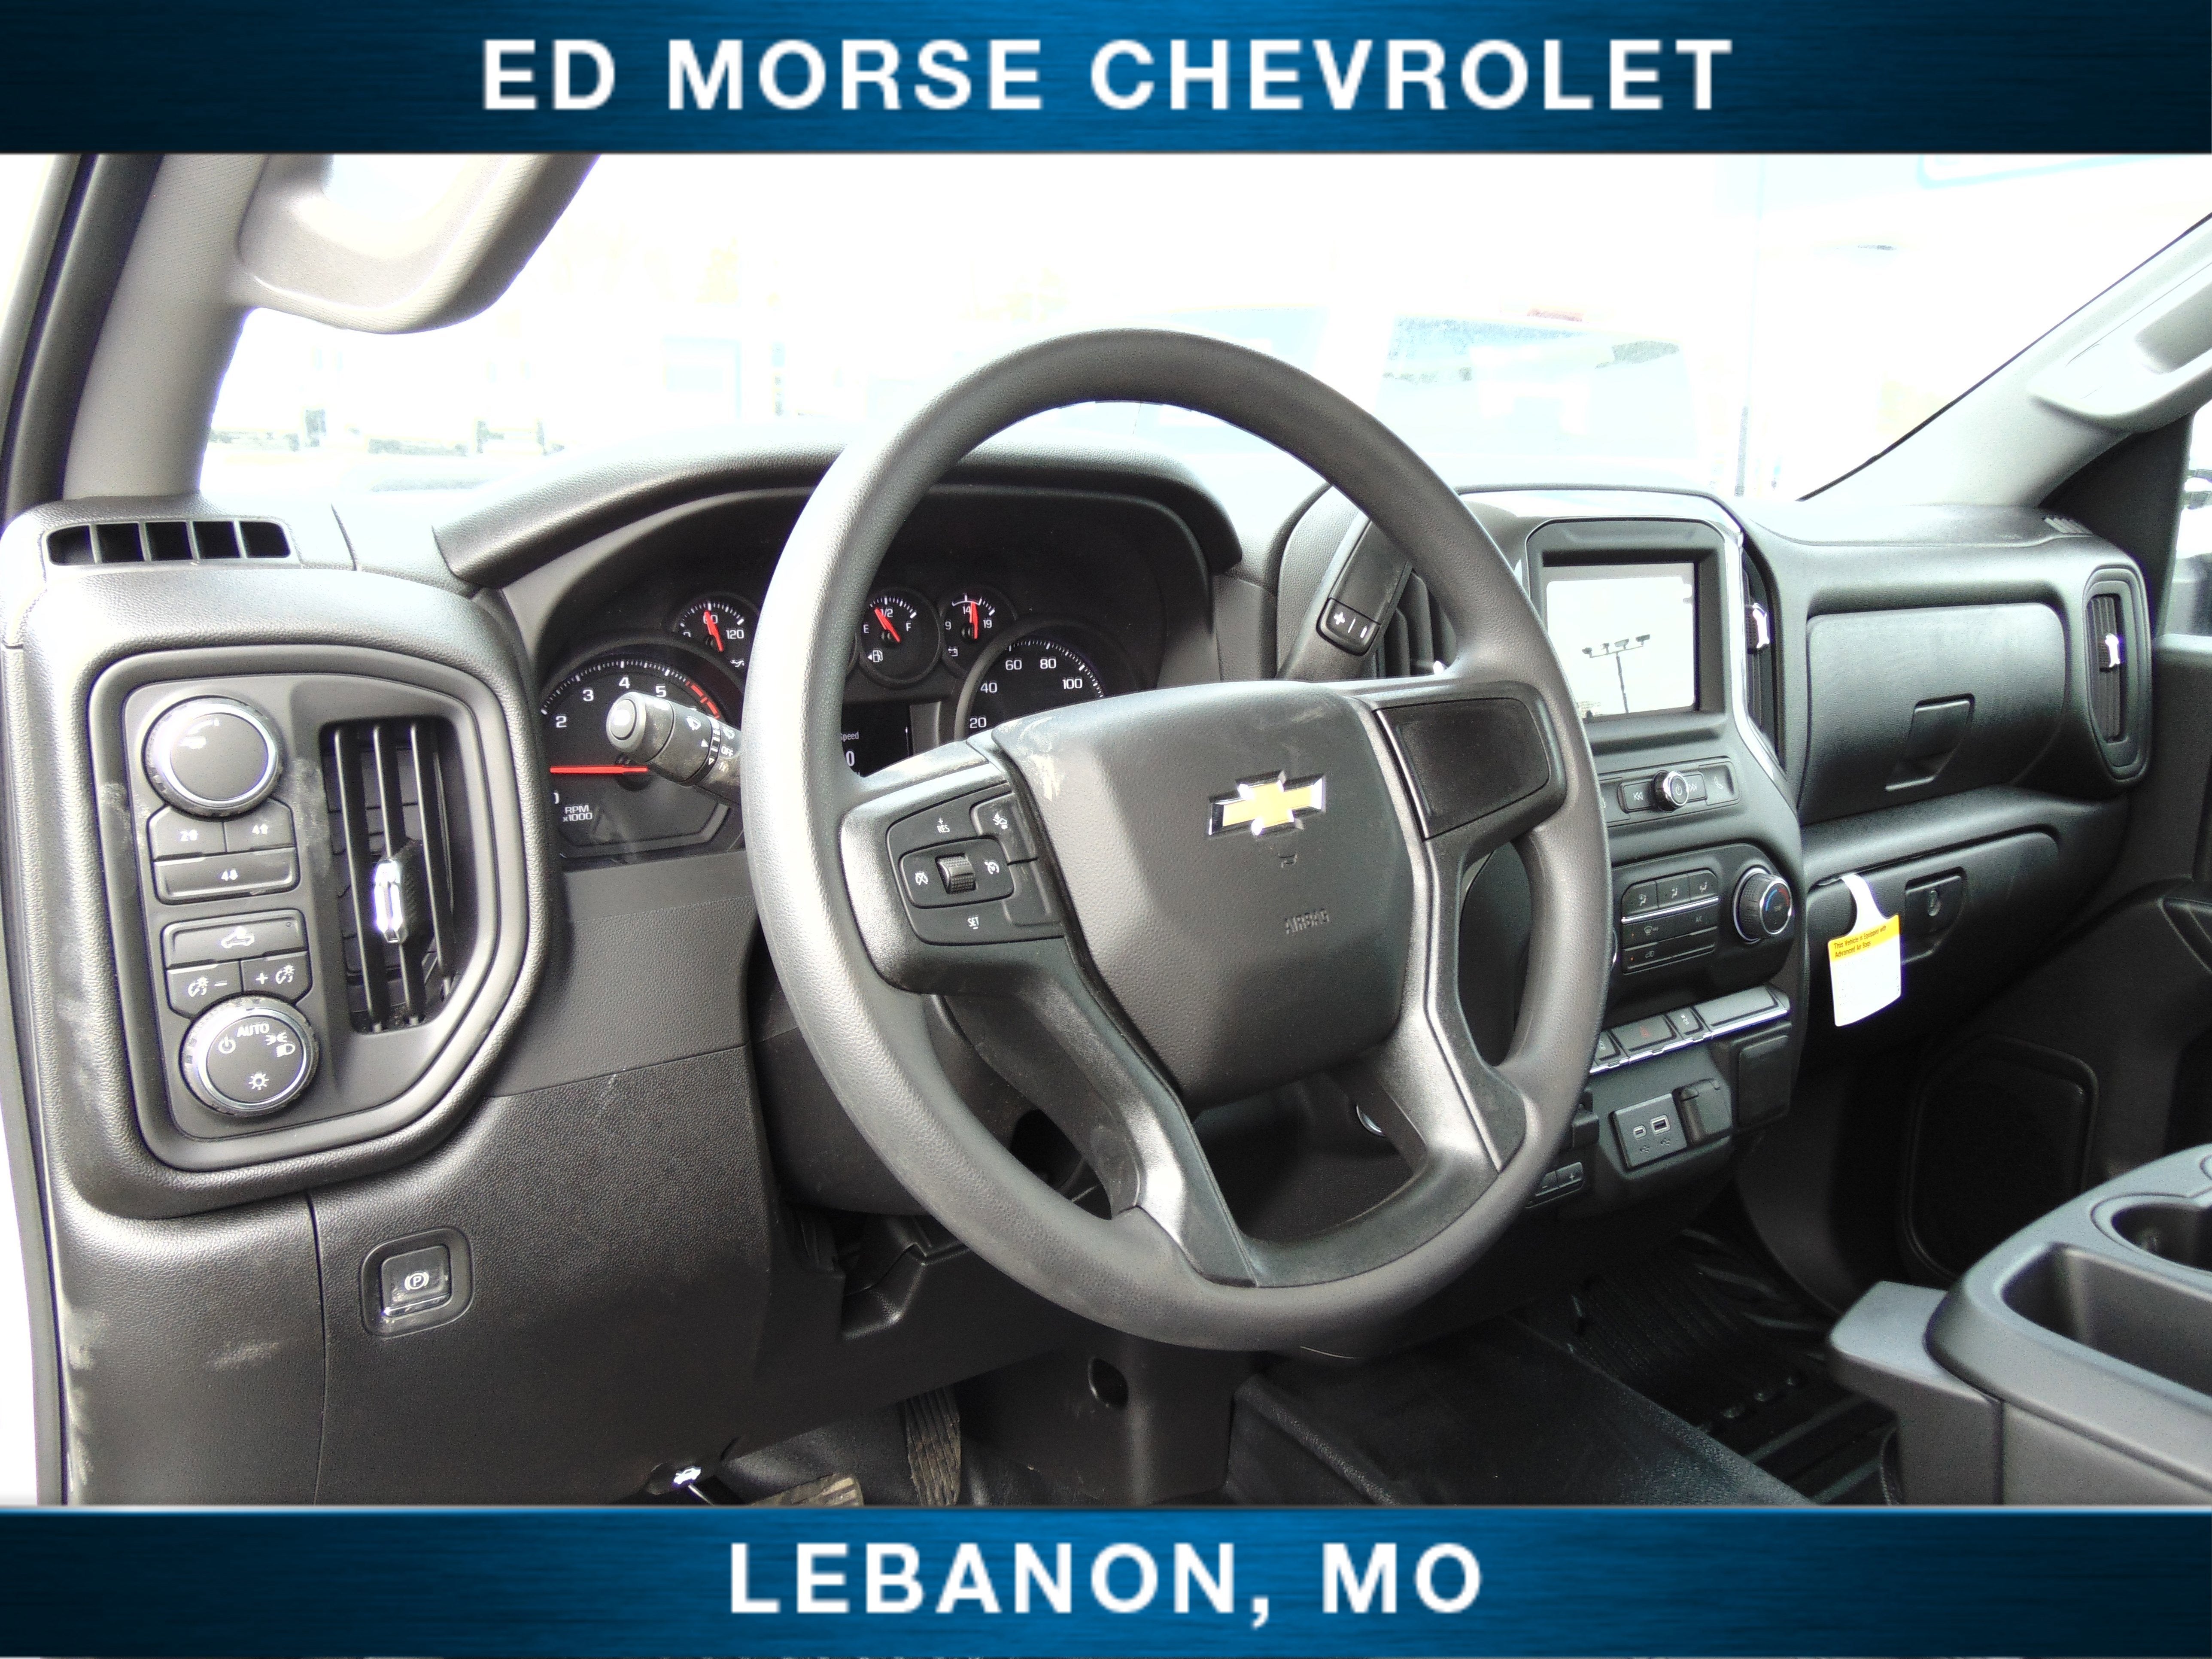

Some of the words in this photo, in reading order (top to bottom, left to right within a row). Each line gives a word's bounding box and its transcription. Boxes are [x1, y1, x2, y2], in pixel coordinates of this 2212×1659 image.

[863, 624, 869, 633] E
[905, 623, 912, 632] F
[945, 621, 951, 630] 9
[983, 619, 992, 628] 19
[726, 629, 744, 639] 120
[1005, 659, 1022, 671] 60
[1040, 658, 1057, 669] 80
[619, 677, 630, 689] 4
[980, 682, 997, 693] 40
[1062, 678, 1083, 690] 100
[582, 689, 594, 702] 3
[655, 685, 667, 698] 5
[555, 715, 567, 728] 2
[969, 717, 987, 729] 20
[721, 746, 734, 757] OFF
[846, 750, 855, 767] 0
[565, 805, 589, 814] RPM
[562, 812, 593, 823] x1000
[936, 824, 950, 833] RES
[967, 916, 980, 927] SET
[1285, 909, 1330, 934] AIRBAG
[1844, 936, 1859, 946] Vehicle
[1863, 929, 1879, 939] Equipped
[1835, 947, 1856, 958] Advanced
[237, 1023, 270, 1037] AUTO
